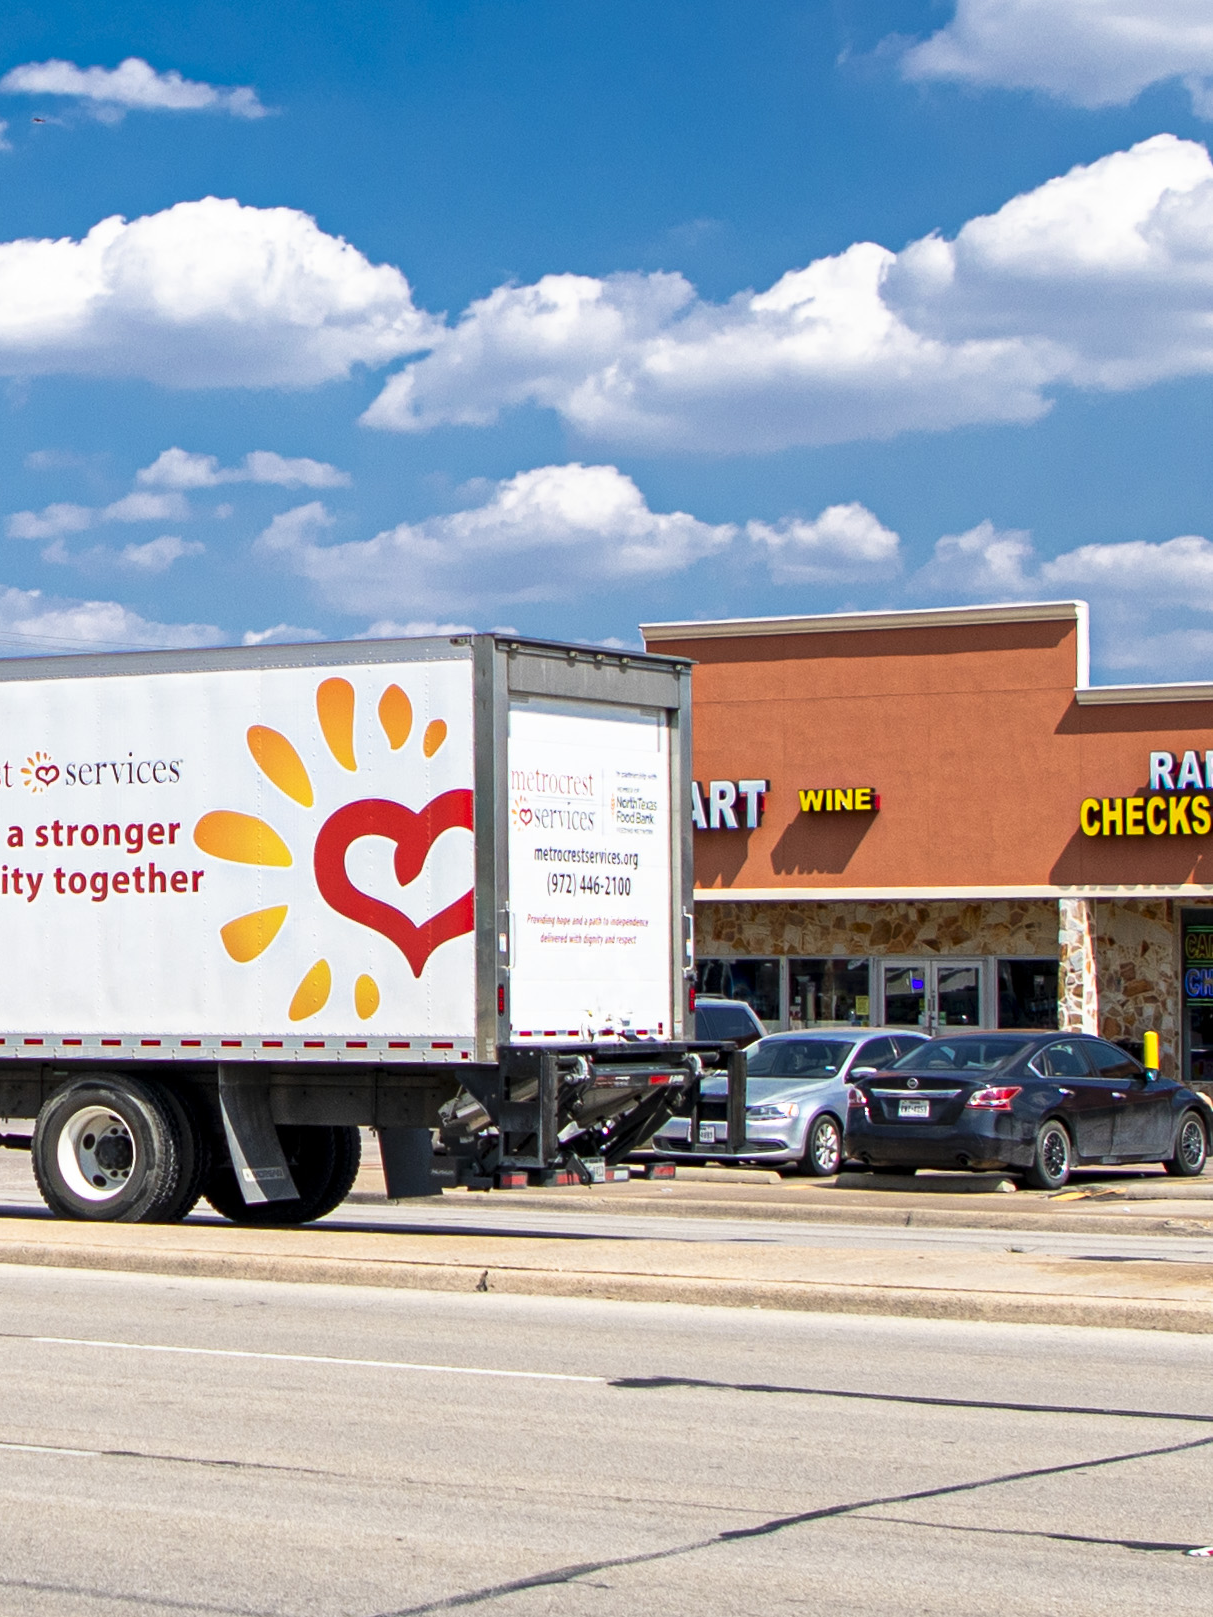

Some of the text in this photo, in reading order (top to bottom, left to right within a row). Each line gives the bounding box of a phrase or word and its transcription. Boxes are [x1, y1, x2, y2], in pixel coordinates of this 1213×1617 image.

[65, 752, 182, 787] services
[511, 769, 594, 797] metrocrest
[616, 796, 657, 811] North Texas
[798, 788, 872, 812] WINE
[534, 802, 596, 831] services
[616, 810, 655, 825] Food Bank
[1080, 795, 1211, 836] CHECKS
[7, 825, 24, 847] a
[35, 820, 181, 854] stronger
[534, 846, 639, 870] metrocrestservices.org
[53, 863, 205, 902] together
[547, 872, 632, 897] (972) 446-2100
[527, 913, 555, 928] Providing
[556, 916, 570, 927] hope
[572, 915, 583, 926] and
[589, 917, 602, 928] path
[610, 916, 649, 927] independence
[540, 932, 637, 947] delivered with dignity and respect
